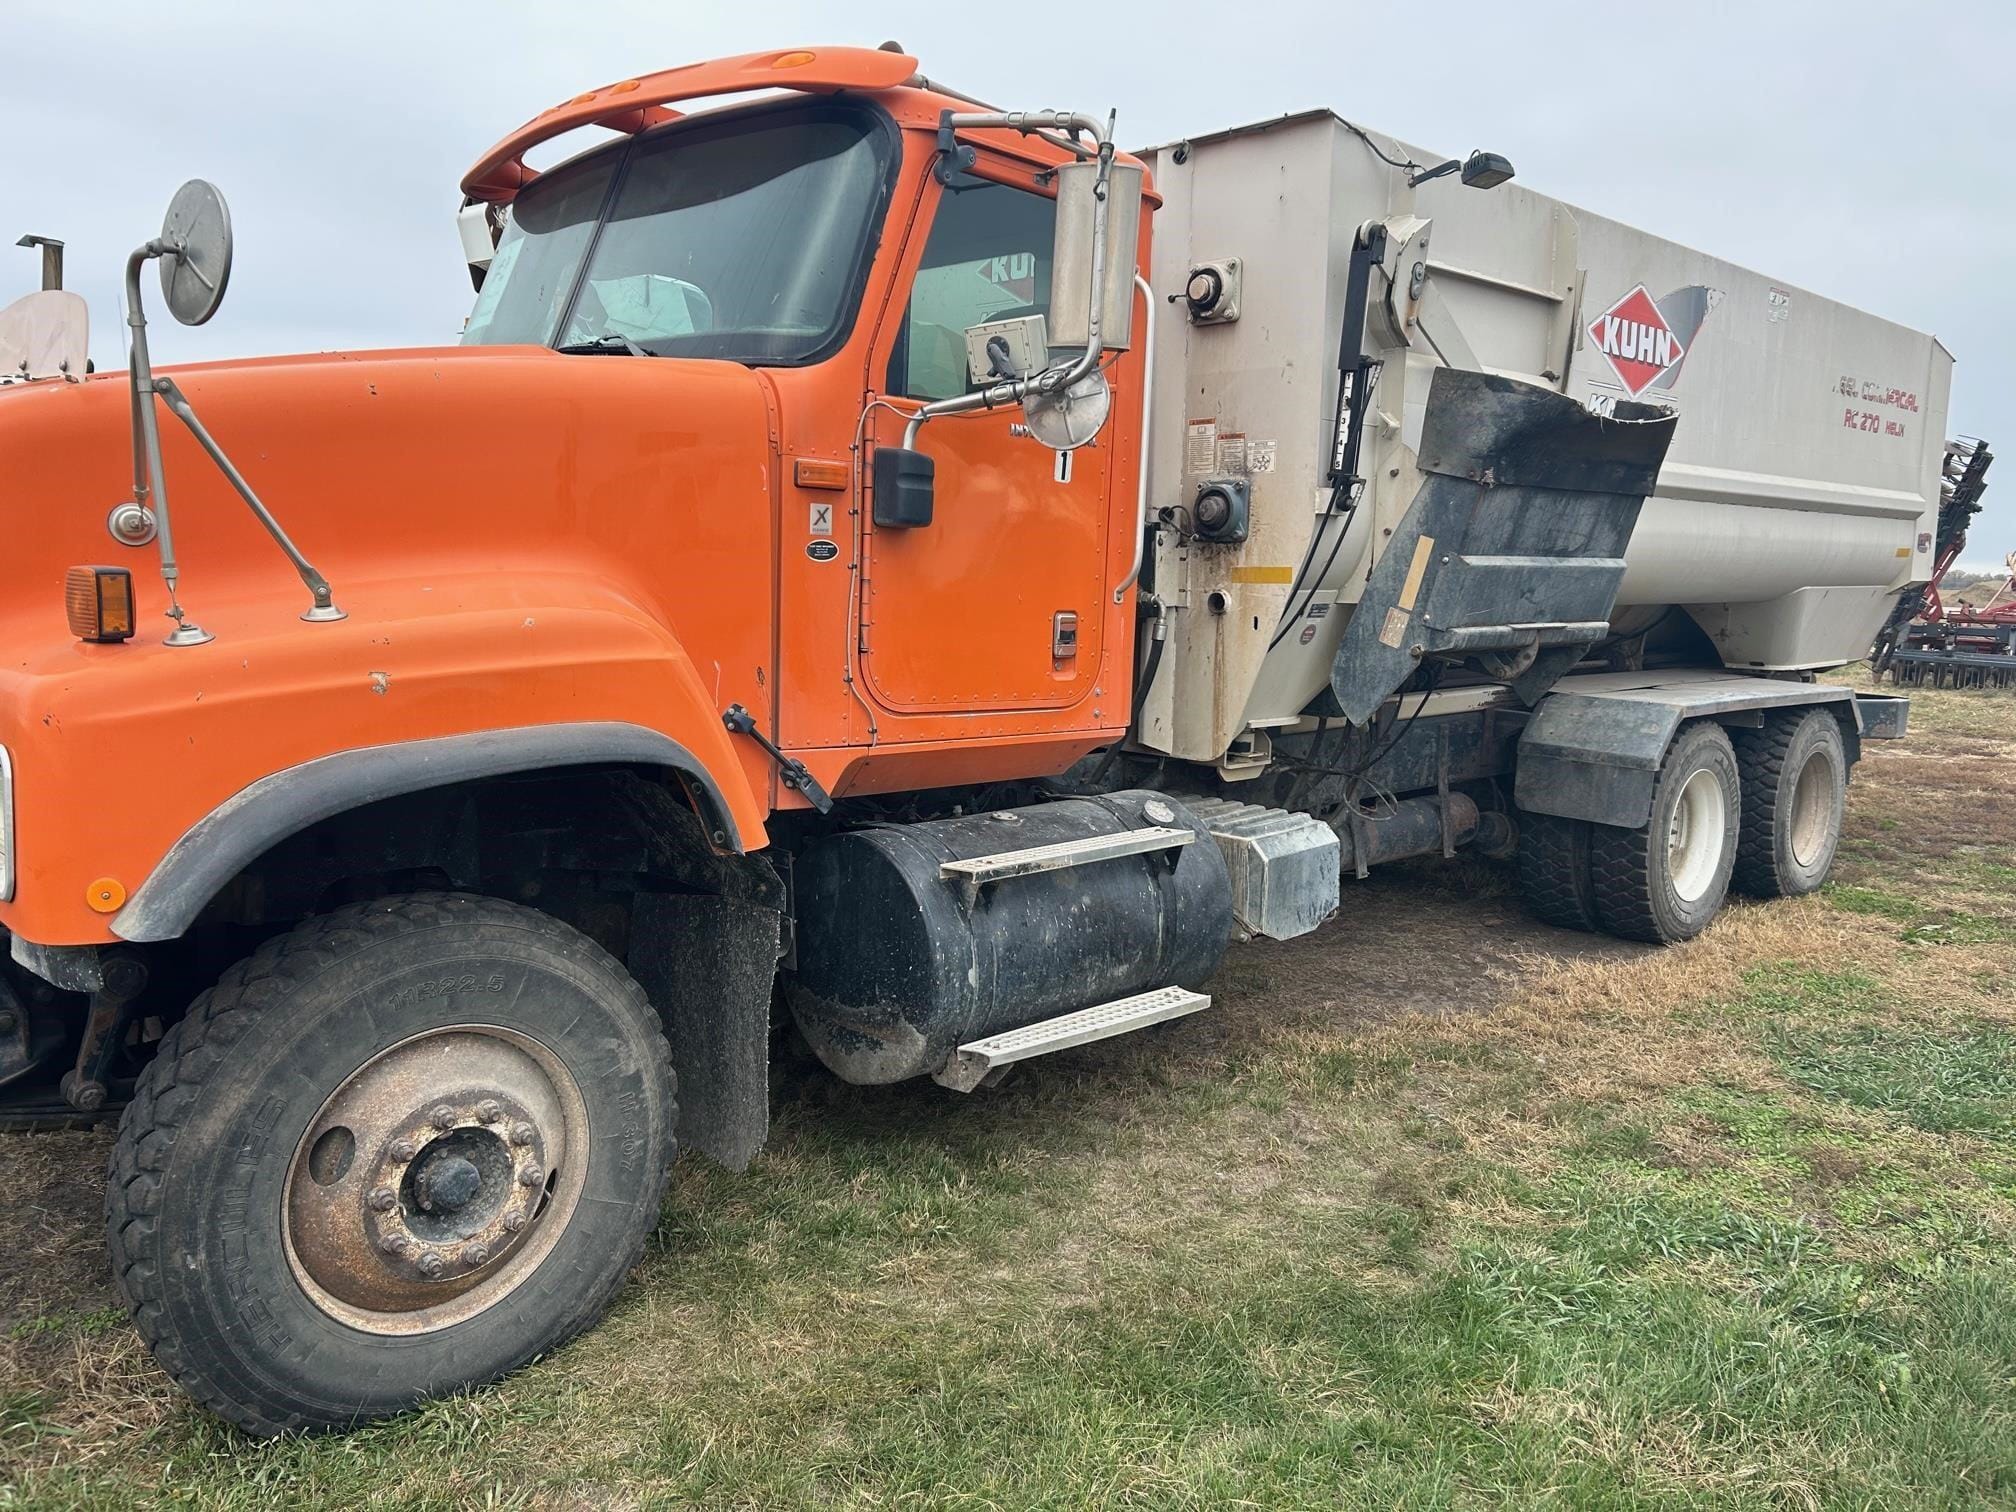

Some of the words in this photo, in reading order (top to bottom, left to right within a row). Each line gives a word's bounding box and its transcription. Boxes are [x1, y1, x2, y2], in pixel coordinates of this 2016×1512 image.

[1602, 313, 1672, 368] KUHN
[1843, 408, 1859, 429] RC
[1860, 412, 1880, 433] 270
[1061, 451, 1068, 480] 1
[221, 1092, 294, 1360] HERCULES
